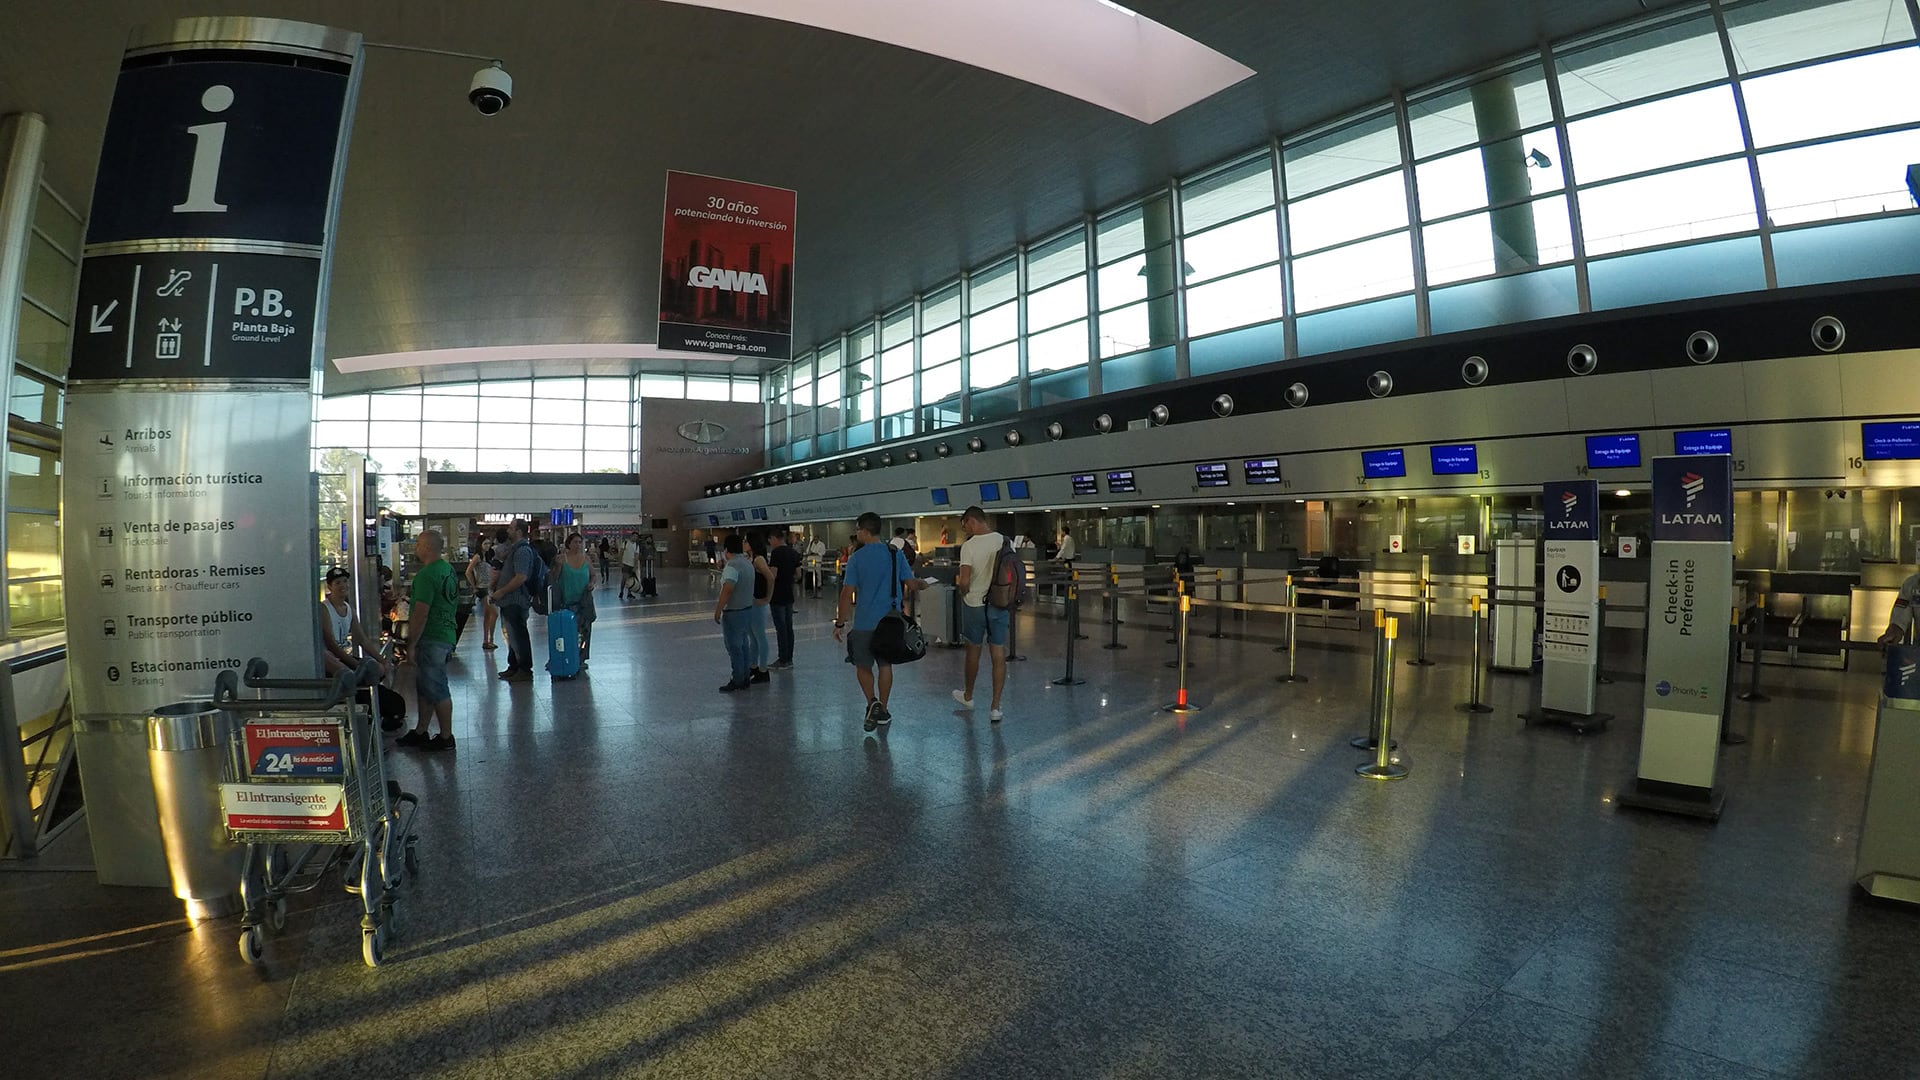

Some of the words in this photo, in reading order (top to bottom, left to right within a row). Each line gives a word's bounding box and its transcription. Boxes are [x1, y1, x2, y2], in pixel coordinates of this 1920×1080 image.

[706, 196, 725, 210] 30
[726, 200, 759, 215] años
[674, 207, 734, 223] potenciando
[735, 216, 745, 224] tu
[746, 217, 787, 231] inversión
[688, 265, 768, 296] GAMA
[234, 288, 294, 318] P.B.
[232, 322, 269, 334] Planta
[271, 323, 296, 336] Baja
[231, 334, 259, 344] Ground
[260, 335, 281, 343] Level
[685, 338, 767, 353] www.gama-sa.com
[124, 427, 172, 441] Arribos
[125, 444, 156, 454] Arrivals
[1733, 460, 1745, 472] 15
[1848, 457, 1862, 469] 16
[1479, 470, 1490, 480] 13
[1575, 466, 1588, 476] 14
[123, 473, 202, 489] Información
[206, 471, 263, 485] turística
[1356, 476, 1367, 485] 12
[124, 490, 152, 500] Tourist
[155, 489, 207, 499] information
[1550, 520, 1590, 529] LATAM
[1661, 513, 1722, 525] LATAM
[123, 521, 160, 534] Venta
[164, 519, 180, 532] de
[183, 518, 235, 535] pasajes
[124, 537, 150, 547] Ticket
[150, 536, 169, 546] sale
[124, 566, 199, 580] Rentadoras
[209, 563, 266, 577] Remises
[125, 583, 145, 593] Rent
[155, 584, 167, 592] car
[174, 581, 219, 592] Chauffeur
[221, 581, 240, 590] cars
[1664, 560, 1679, 624] Check-in
[1680, 559, 1695, 636] Preferente
[127, 613, 198, 628] Transporte
[201, 610, 253, 626] público
[128, 630, 154, 640] Public
[156, 627, 221, 639] transportation
[131, 657, 241, 674] Estacionamiento
[131, 676, 165, 687] Parking
[256, 729, 266, 738] El
[267, 729, 330, 741] Intransigente
[265, 753, 295, 773] 24
[236, 791, 249, 802] El
[250, 792, 327, 806] Intransigente
